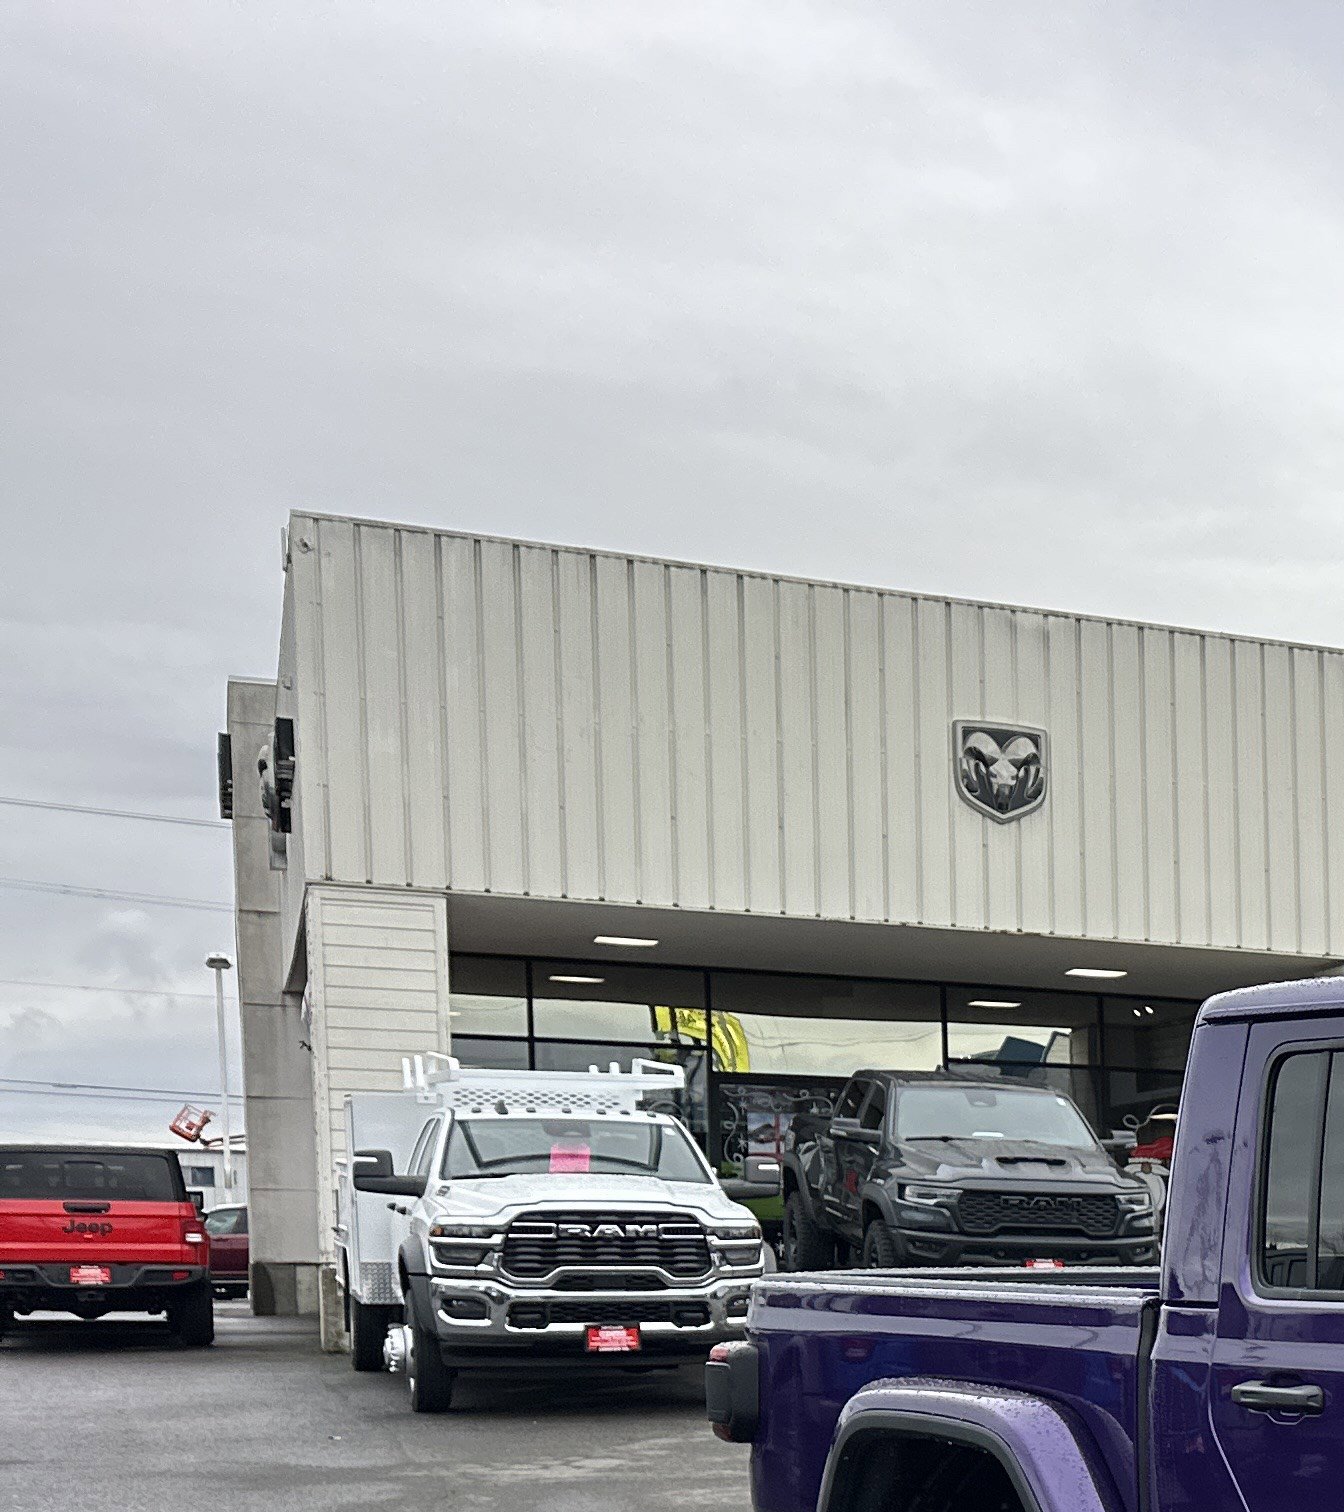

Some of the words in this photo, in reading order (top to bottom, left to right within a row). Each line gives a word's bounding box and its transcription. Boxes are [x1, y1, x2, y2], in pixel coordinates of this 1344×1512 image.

[1000, 1196, 1083, 1212] RAM
[62, 1219, 113, 1236] Jeep
[558, 1224, 658, 1238] RAM
